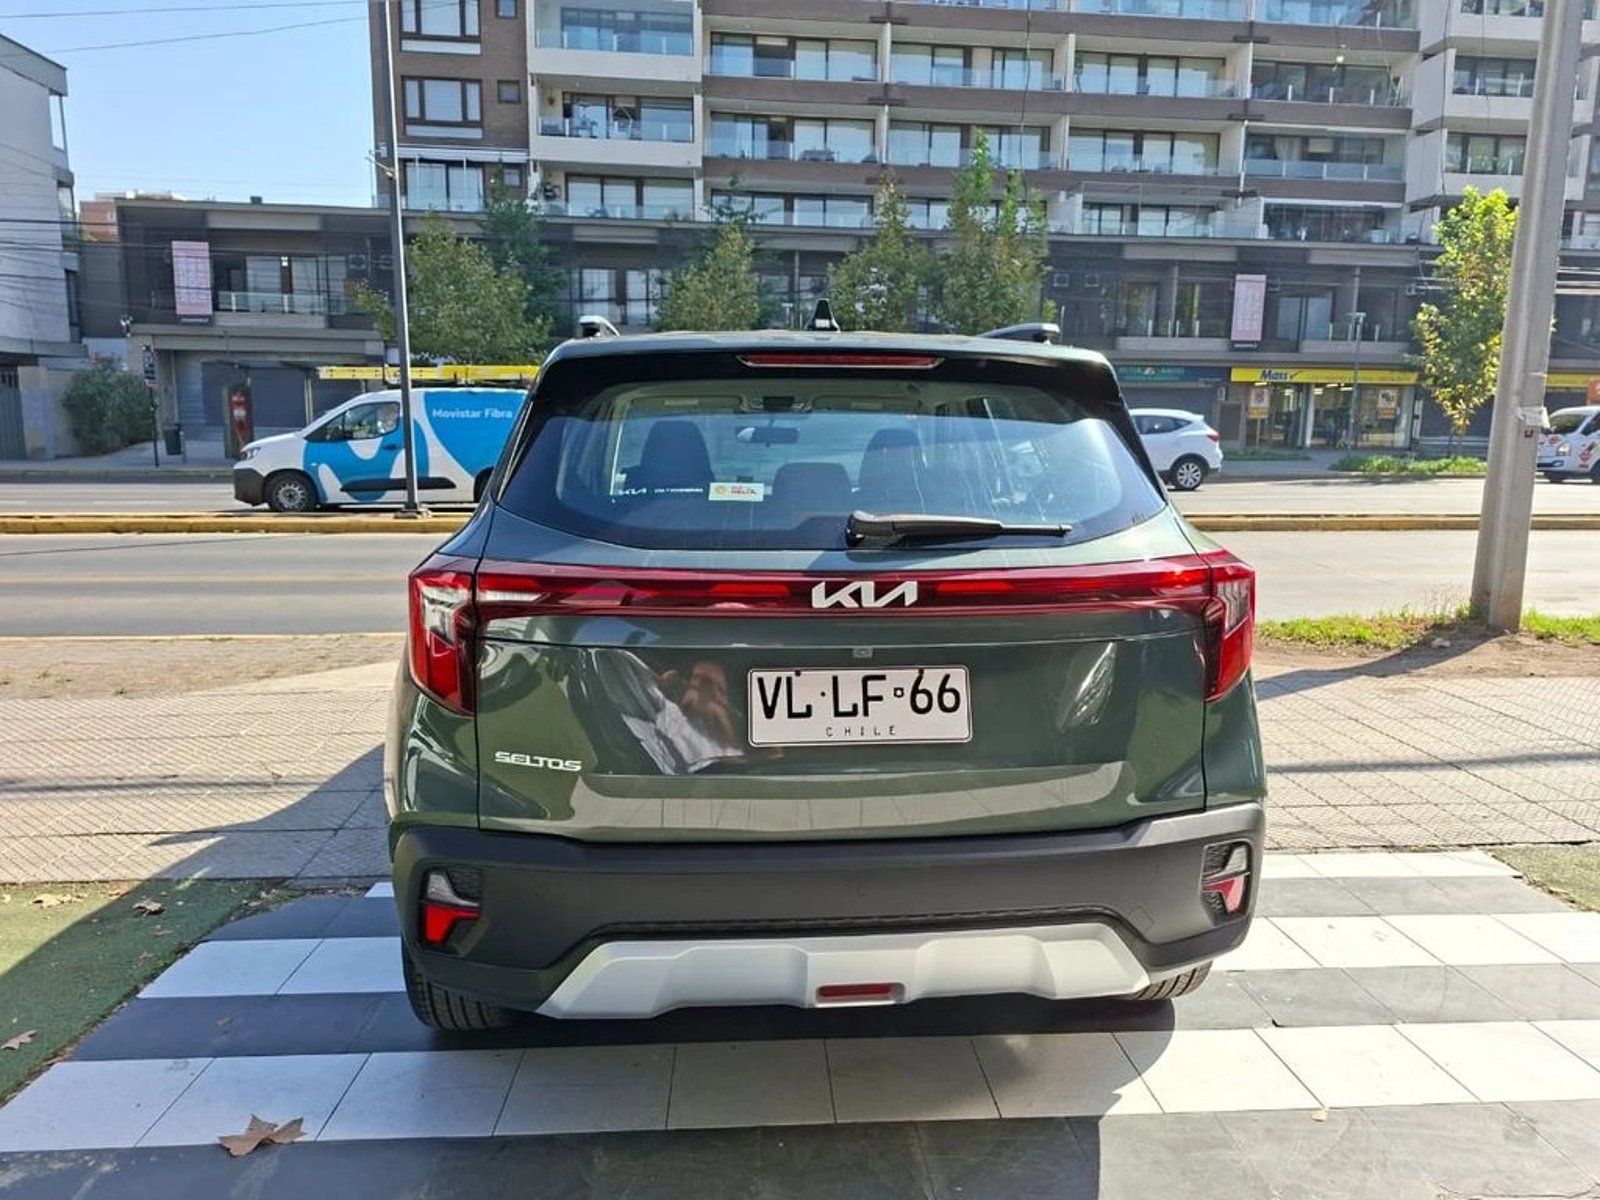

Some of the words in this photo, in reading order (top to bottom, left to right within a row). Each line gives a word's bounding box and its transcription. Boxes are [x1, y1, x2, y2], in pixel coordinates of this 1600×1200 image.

[1260, 369, 1288, 380] Mass
[432, 408, 481, 418] Movistar
[484, 408, 513, 418] Fibra
[811, 580, 918, 608] KIA
[825, 725, 896, 737] CHILE
[494, 751, 582, 772] SELTOS
